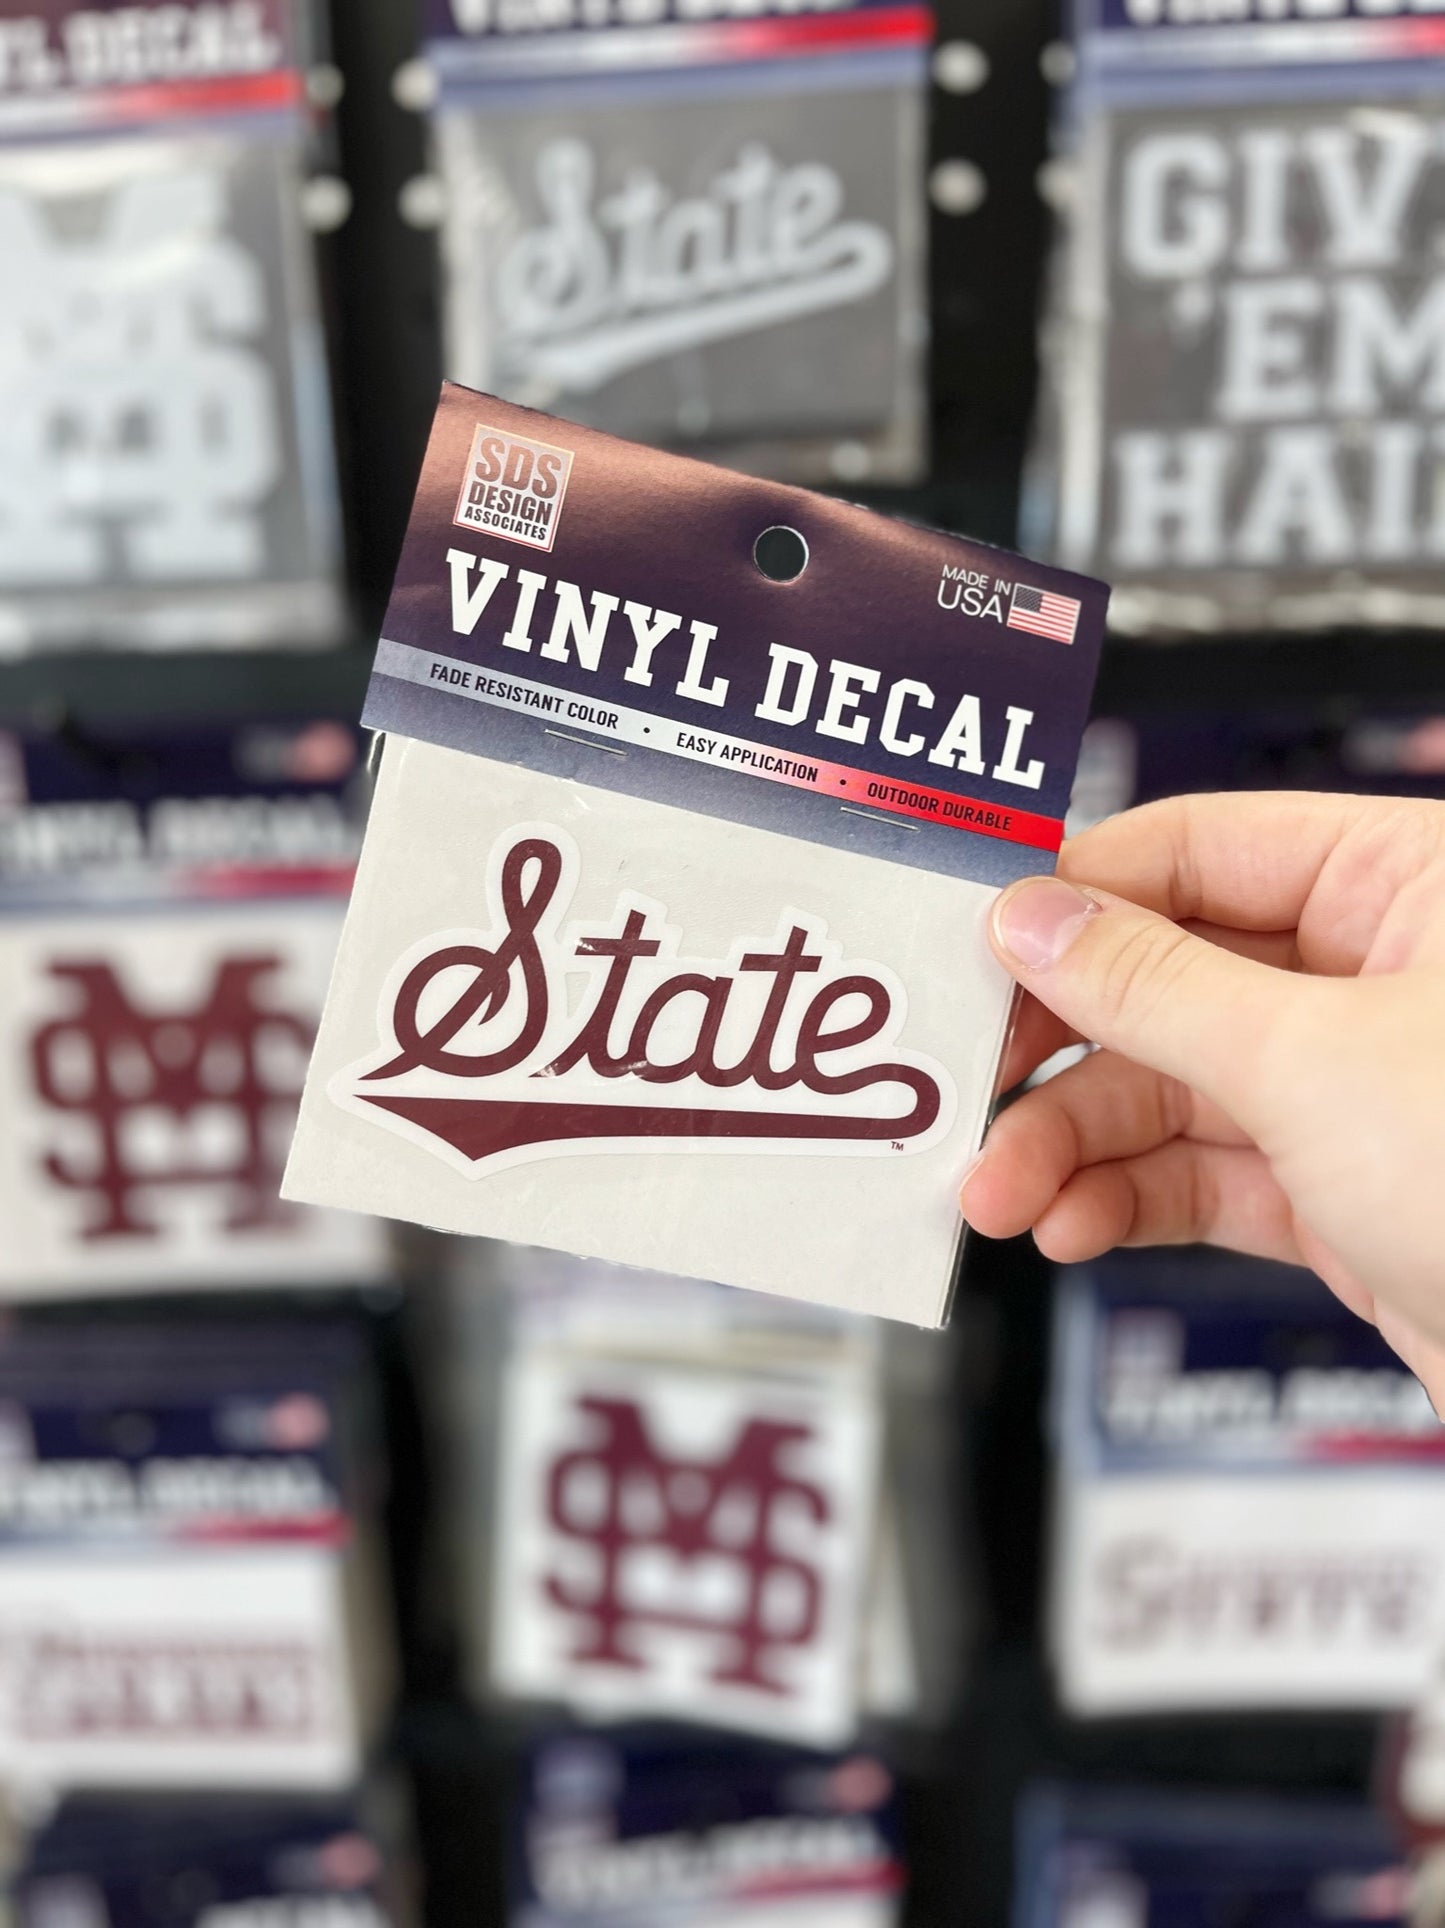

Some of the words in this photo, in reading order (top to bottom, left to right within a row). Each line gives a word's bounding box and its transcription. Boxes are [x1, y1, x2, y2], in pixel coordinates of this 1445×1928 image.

[1120, 126, 1445, 281] GIV
[502, 136, 892, 390] State
[475, 437, 561, 499] SDS
[464, 506, 547, 541] ASSOCIATES
[468, 480, 553, 526] DESIGN
[937, 580, 1002, 623] USA
[942, 564, 989, 589] MADE
[994, 579, 1011, 596] IN
[430, 663, 472, 688] FADE
[475, 675, 564, 714] RESISTANT
[567, 702, 619, 729] COLOR
[446, 547, 730, 707] VINYL
[754, 642, 1045, 790] DECAL
[676, 732, 717, 755] EASY
[720, 745, 818, 782] APPLICATION
[867, 782, 939, 813] OUTDOOR
[942, 801, 1012, 832] DURABLE
[352, 838, 941, 1162] State
